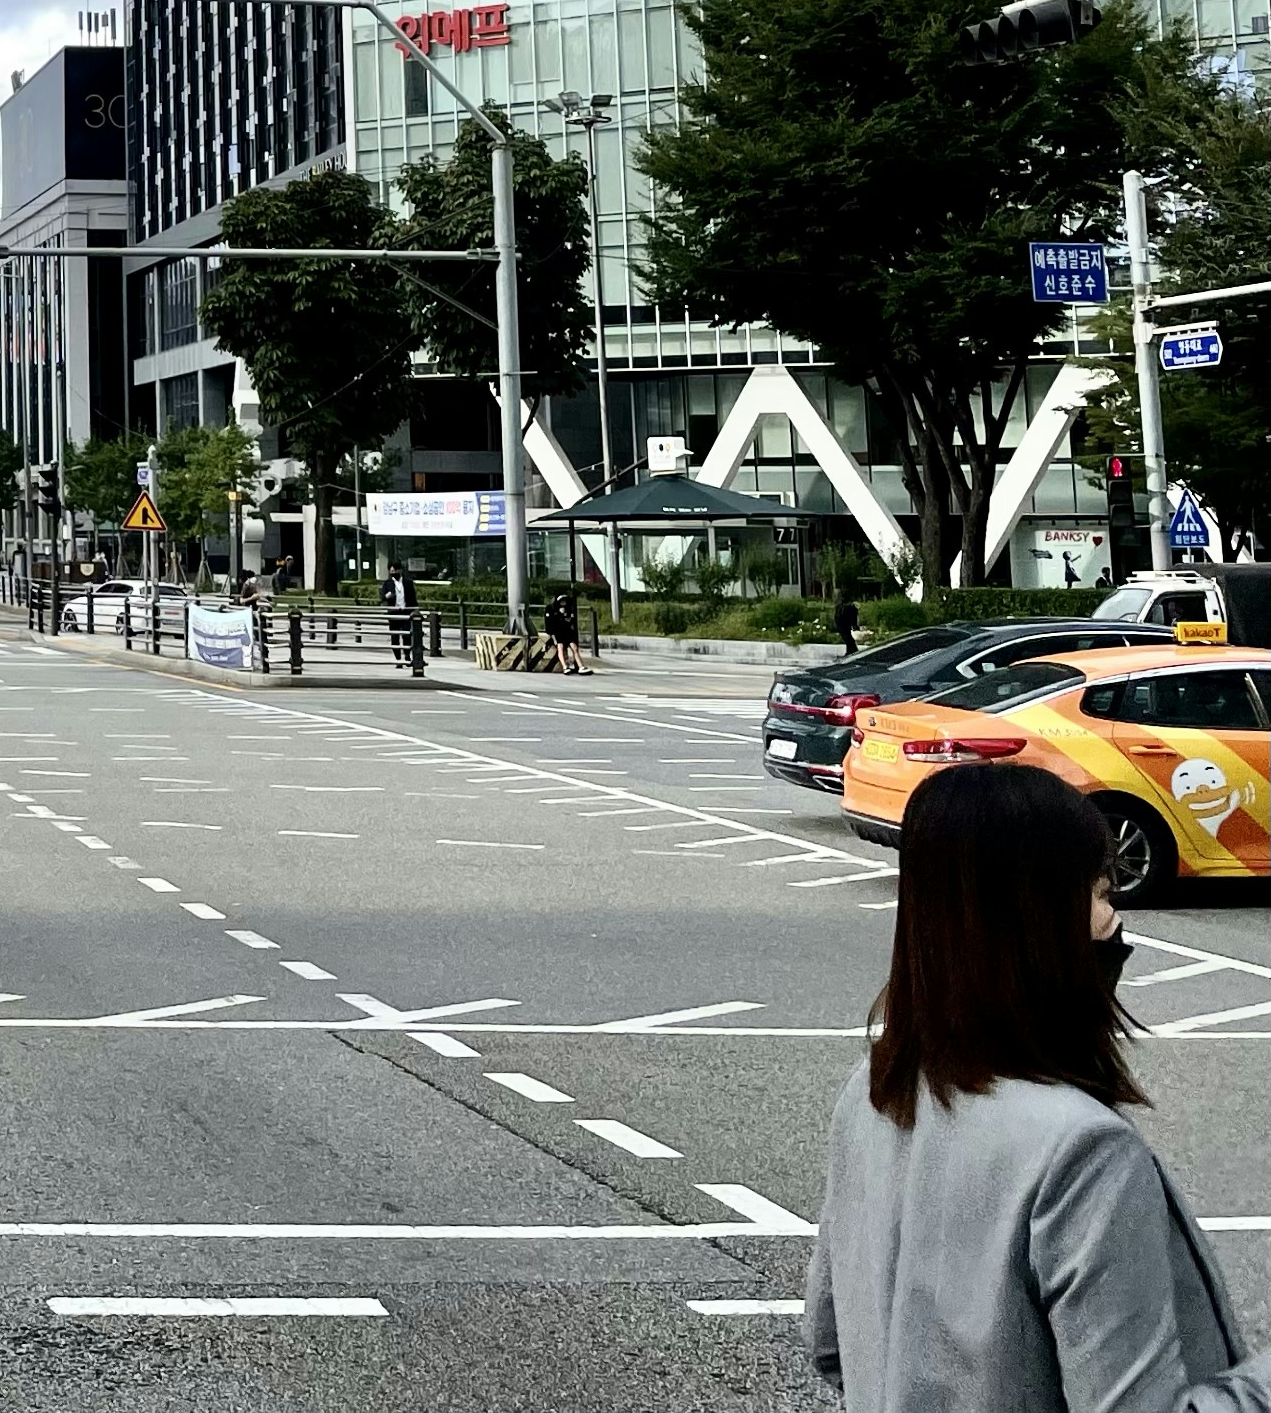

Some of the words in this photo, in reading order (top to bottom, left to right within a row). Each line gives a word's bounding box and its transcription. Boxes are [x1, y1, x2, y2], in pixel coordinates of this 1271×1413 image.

[395, 3, 511, 59] 위메프
[1034, 249, 1102, 270] 예측출발금지
[1044, 274, 1096, 295] 신호준수
[1045, 530, 1090, 542] BANKSY
